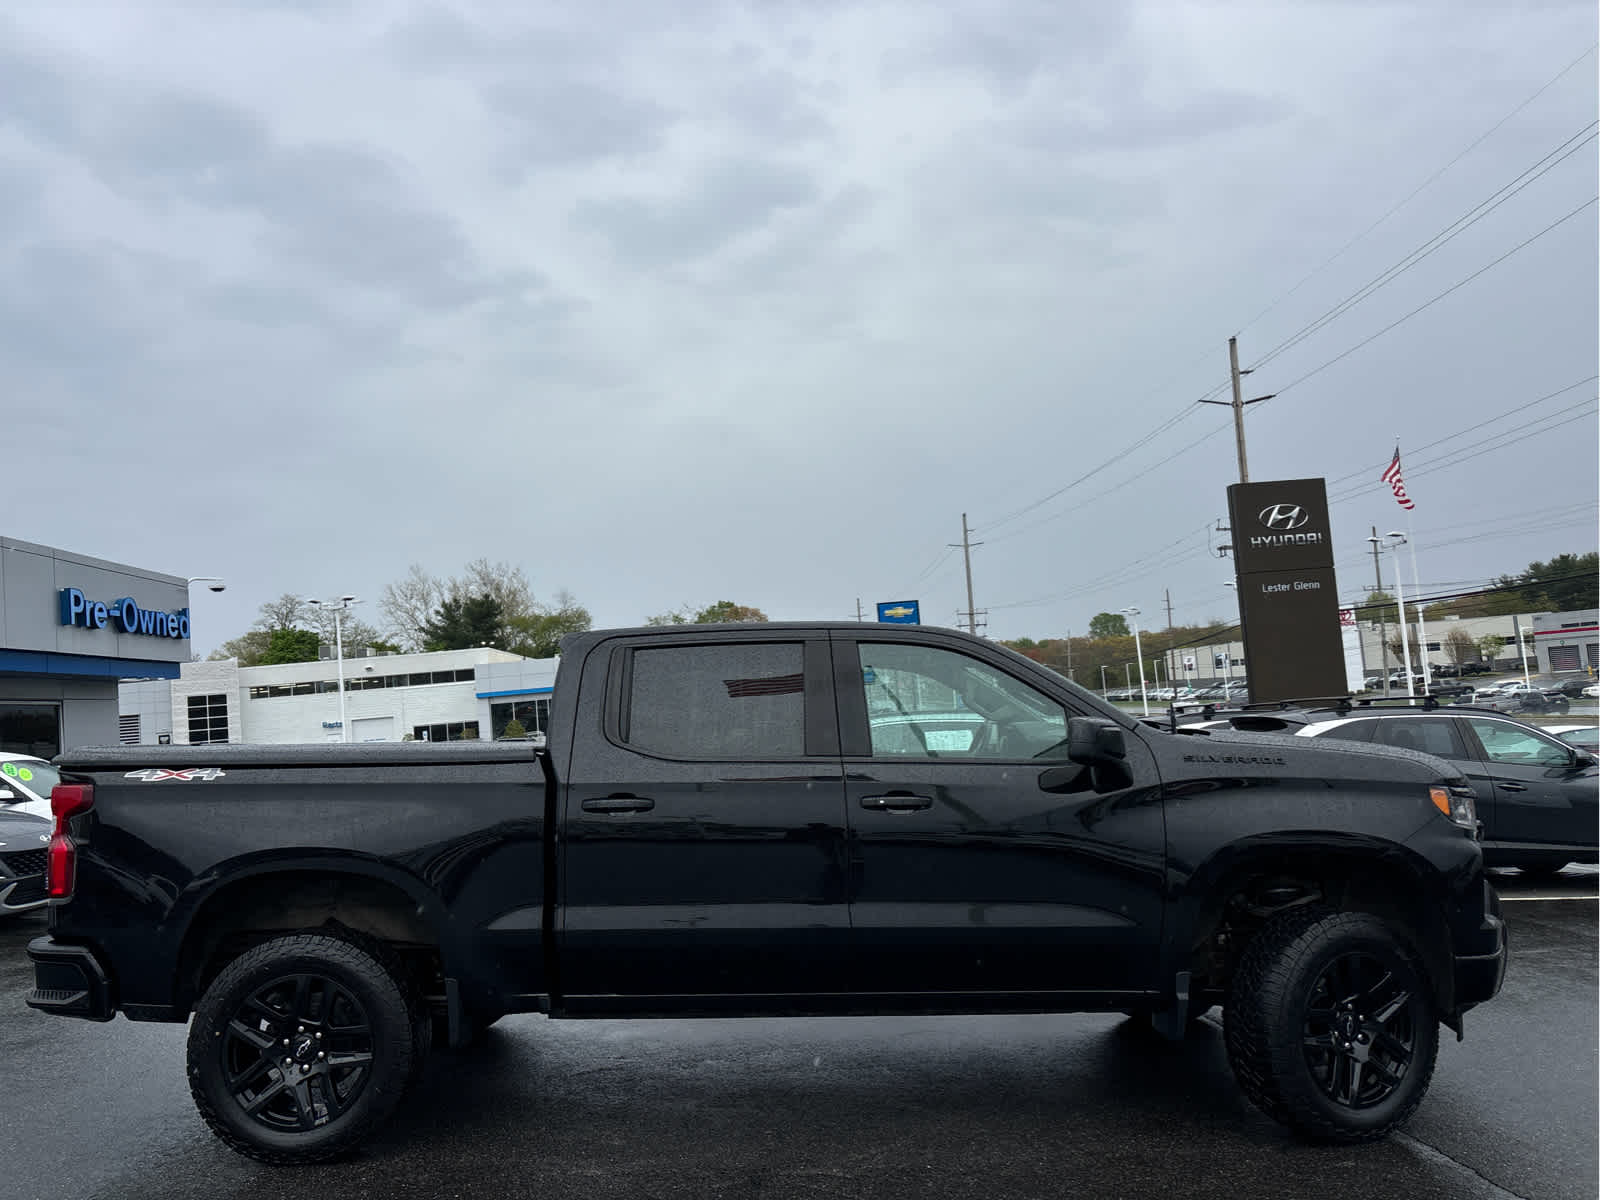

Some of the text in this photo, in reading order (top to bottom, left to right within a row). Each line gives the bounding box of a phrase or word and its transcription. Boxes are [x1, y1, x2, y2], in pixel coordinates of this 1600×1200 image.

[1250, 532, 1322, 549] HYUNDAI
[1262, 580, 1321, 593] Lester Glenn
[60, 587, 190, 639] Pre-Owned
[1183, 754, 1287, 766] SILVERADO
